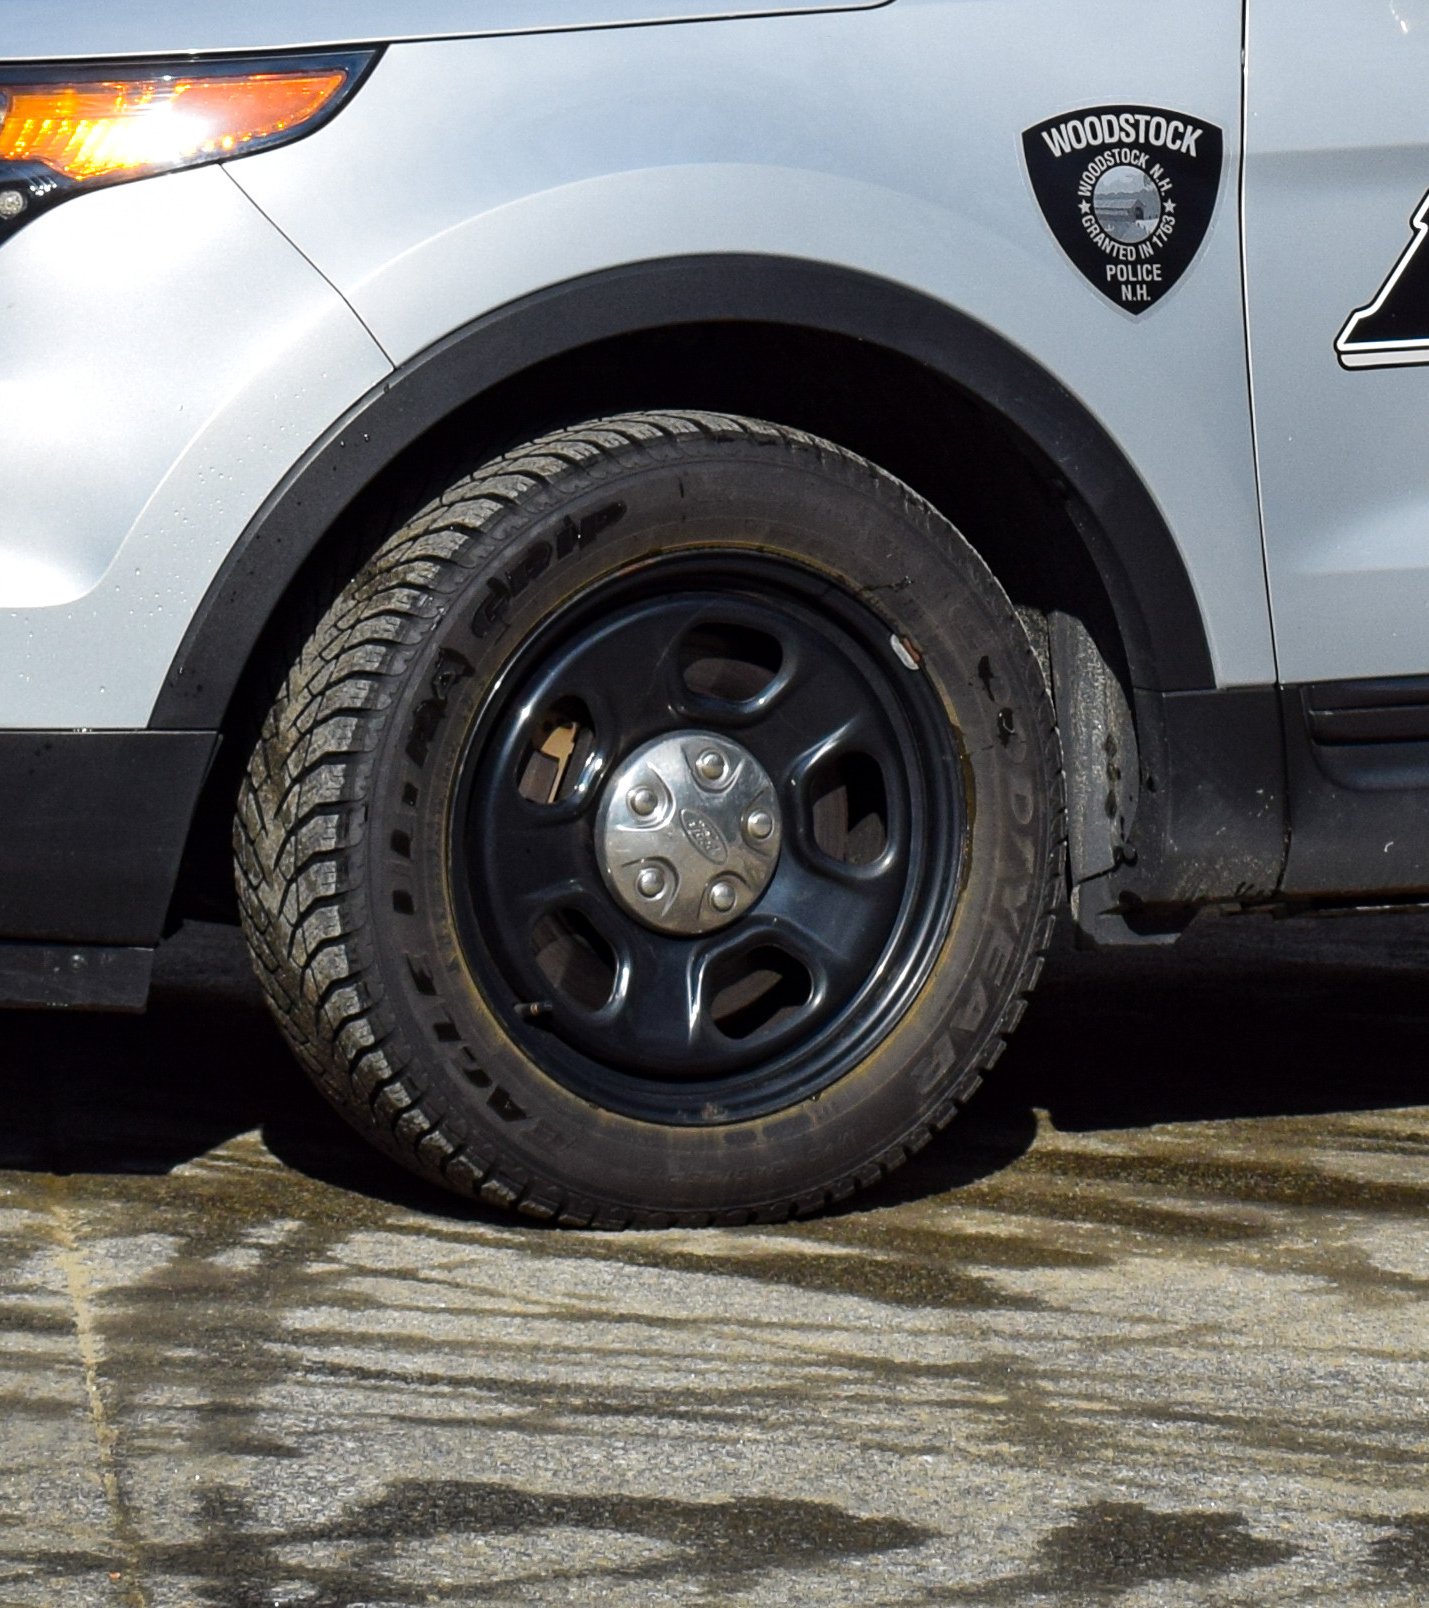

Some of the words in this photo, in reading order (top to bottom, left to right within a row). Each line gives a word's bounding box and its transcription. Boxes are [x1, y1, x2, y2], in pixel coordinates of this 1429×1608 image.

[1041, 113, 1204, 159] WOODSTOCK
[1077, 147, 1150, 197] WOODSTOCK
[1149, 163, 1174, 197] N.H.
[1081, 215, 1136, 261] GRANTED
[1138, 243, 1155, 260] IN
[1152, 215, 1176, 249] 1763
[1105, 264, 1163, 282] POLICE
[1120, 285, 1152, 302] N.H.
[472, 500, 627, 639] GRIP
